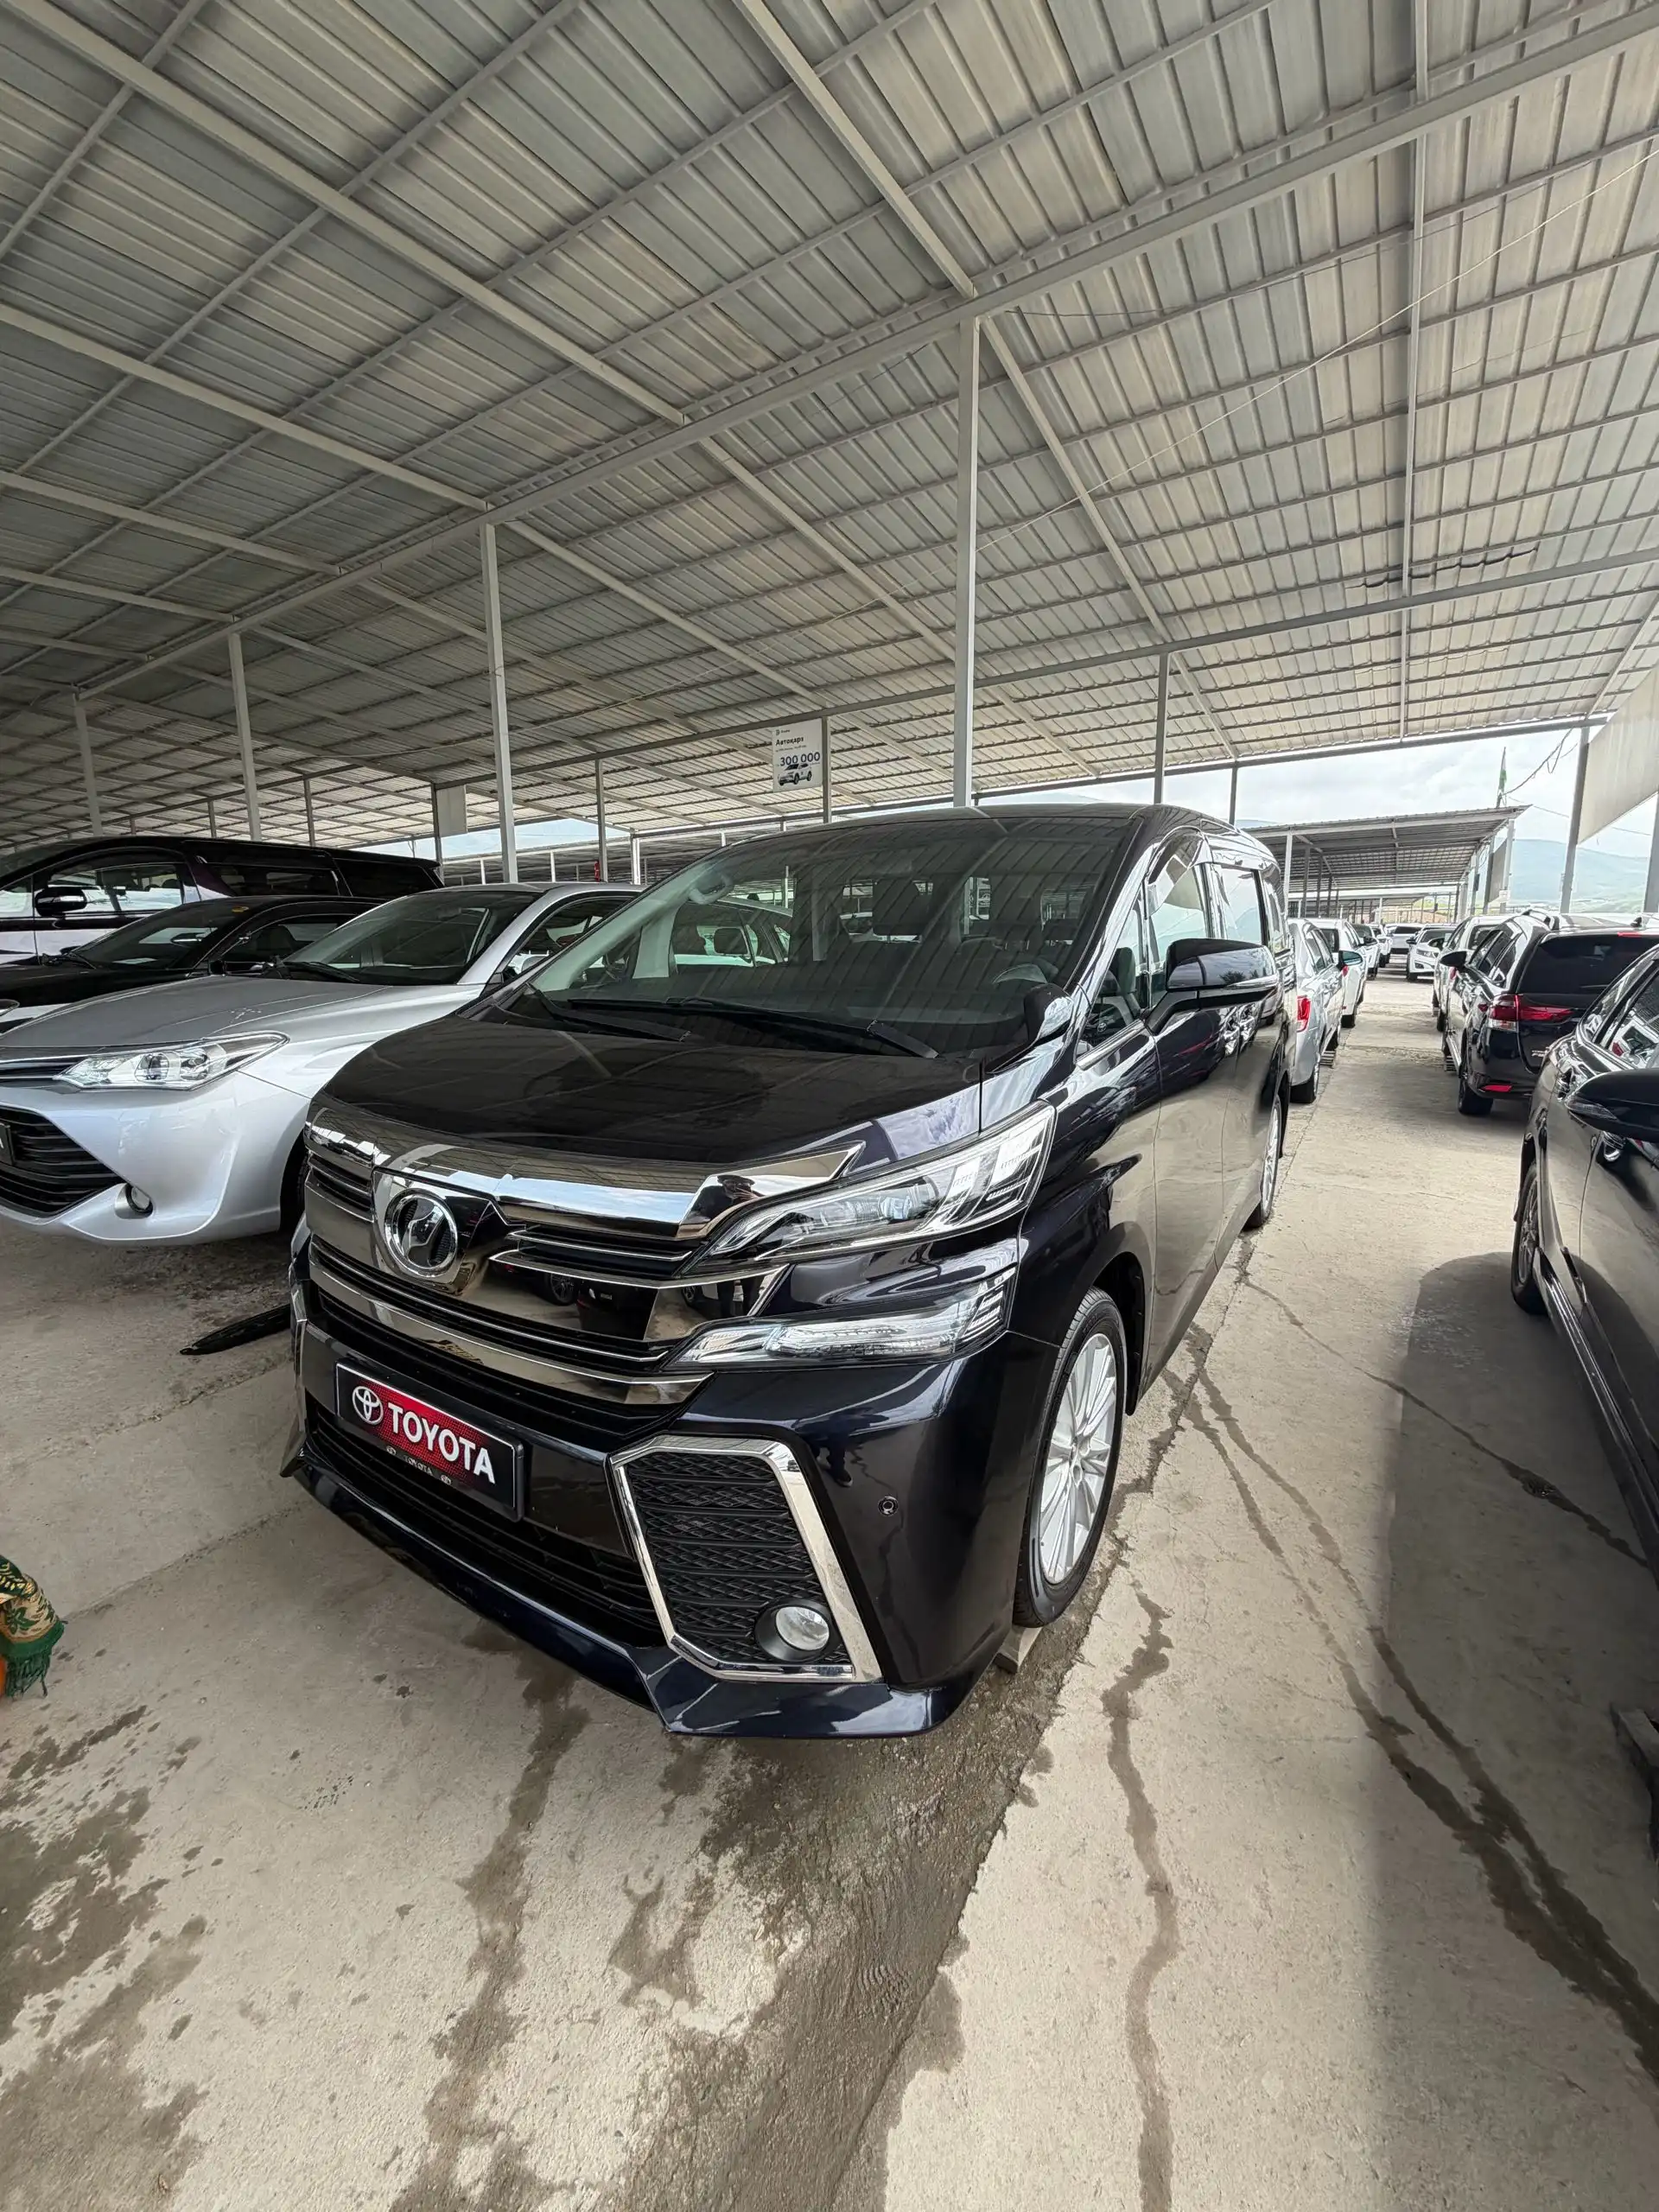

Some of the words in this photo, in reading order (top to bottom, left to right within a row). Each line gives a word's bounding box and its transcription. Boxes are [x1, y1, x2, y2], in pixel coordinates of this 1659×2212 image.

[780, 755, 798, 766] 300
[801, 752, 821, 763] 000
[388, 1402, 496, 1484] TOYOTA
